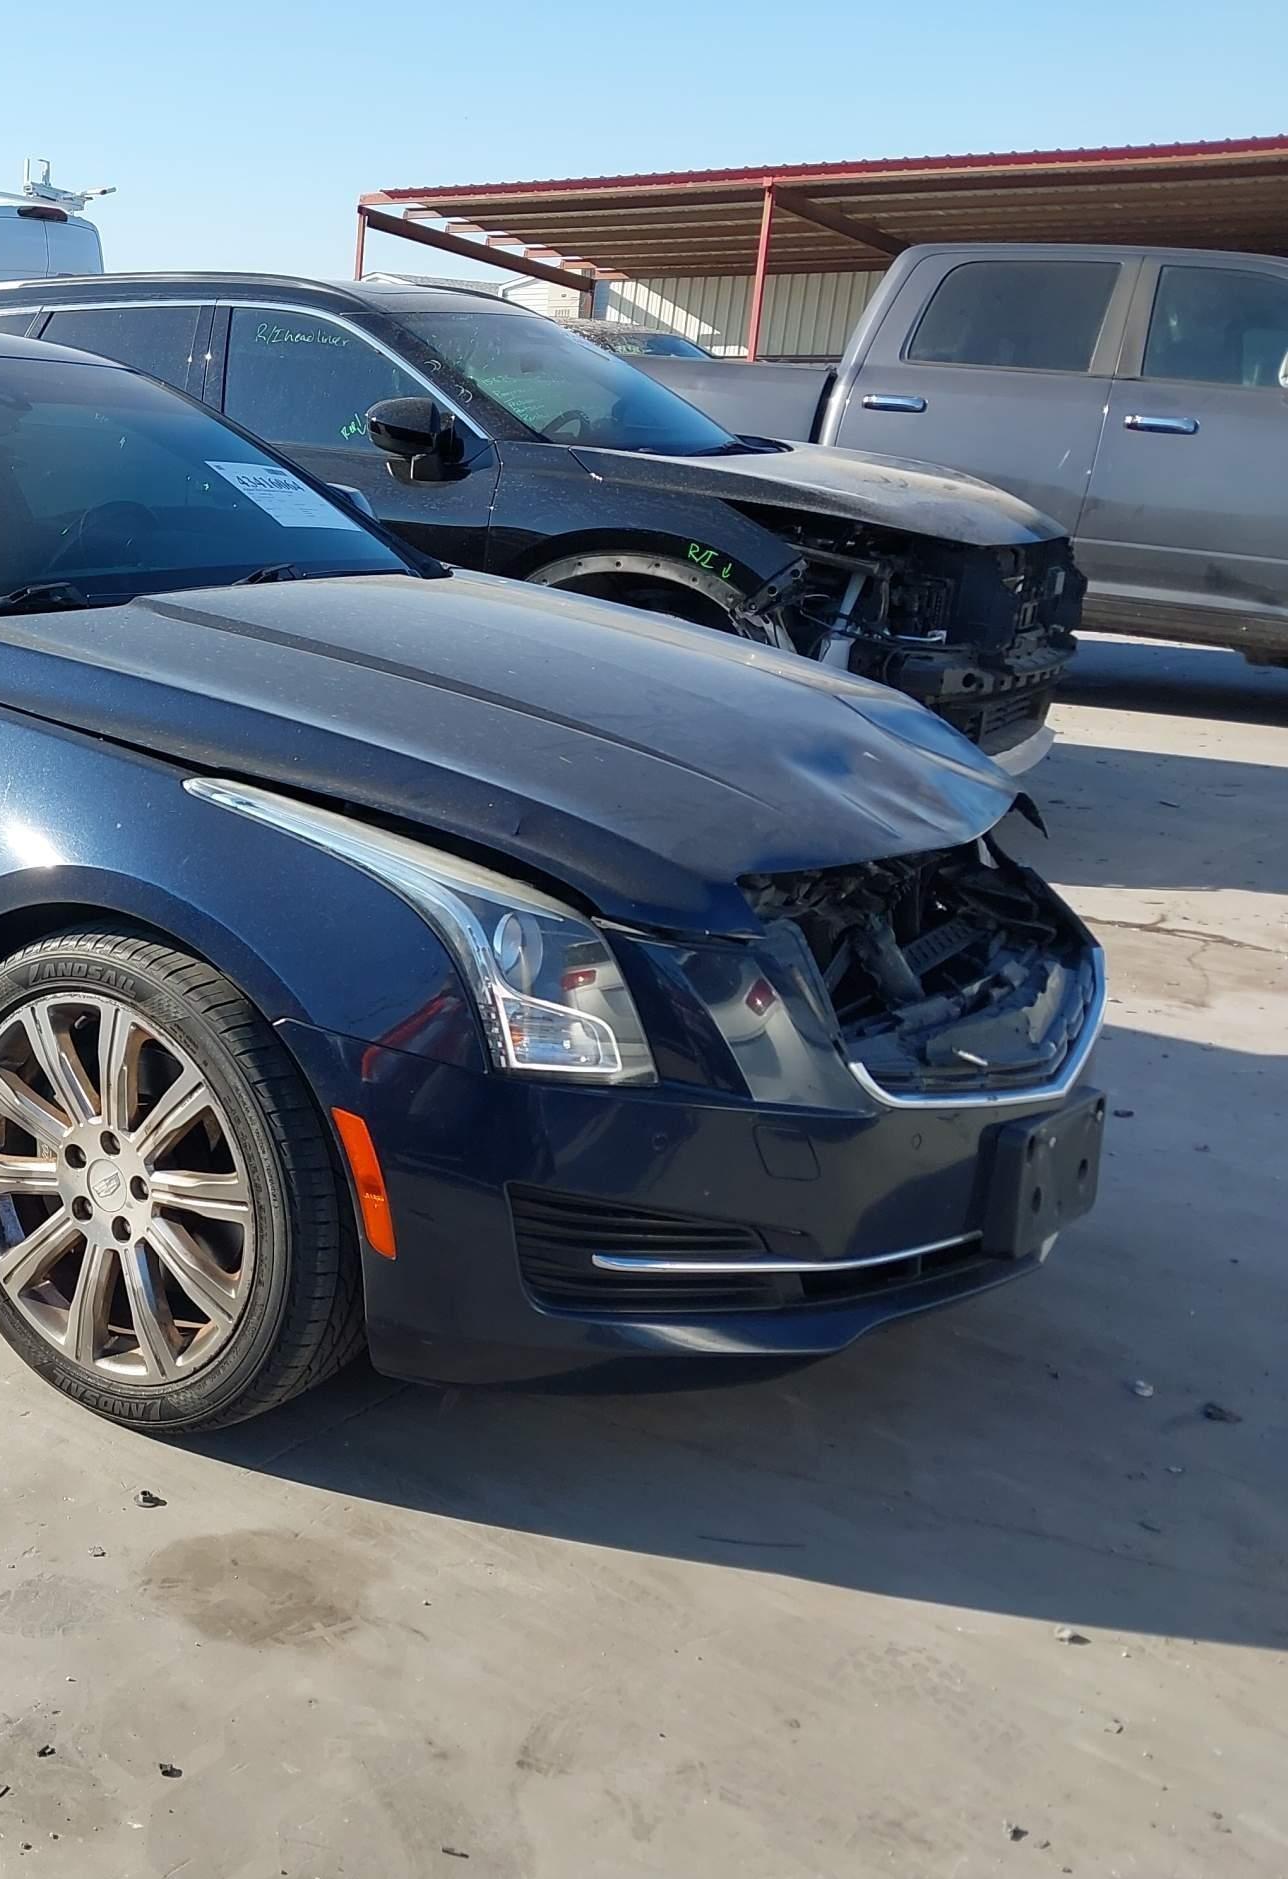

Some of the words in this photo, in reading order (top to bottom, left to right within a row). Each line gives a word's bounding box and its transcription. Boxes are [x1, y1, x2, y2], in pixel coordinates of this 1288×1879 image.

[236, 475, 305, 492] 43416064
[28, 961, 137, 999] LANDSAIL
[52, 1369, 162, 1422] LANDSAIL
